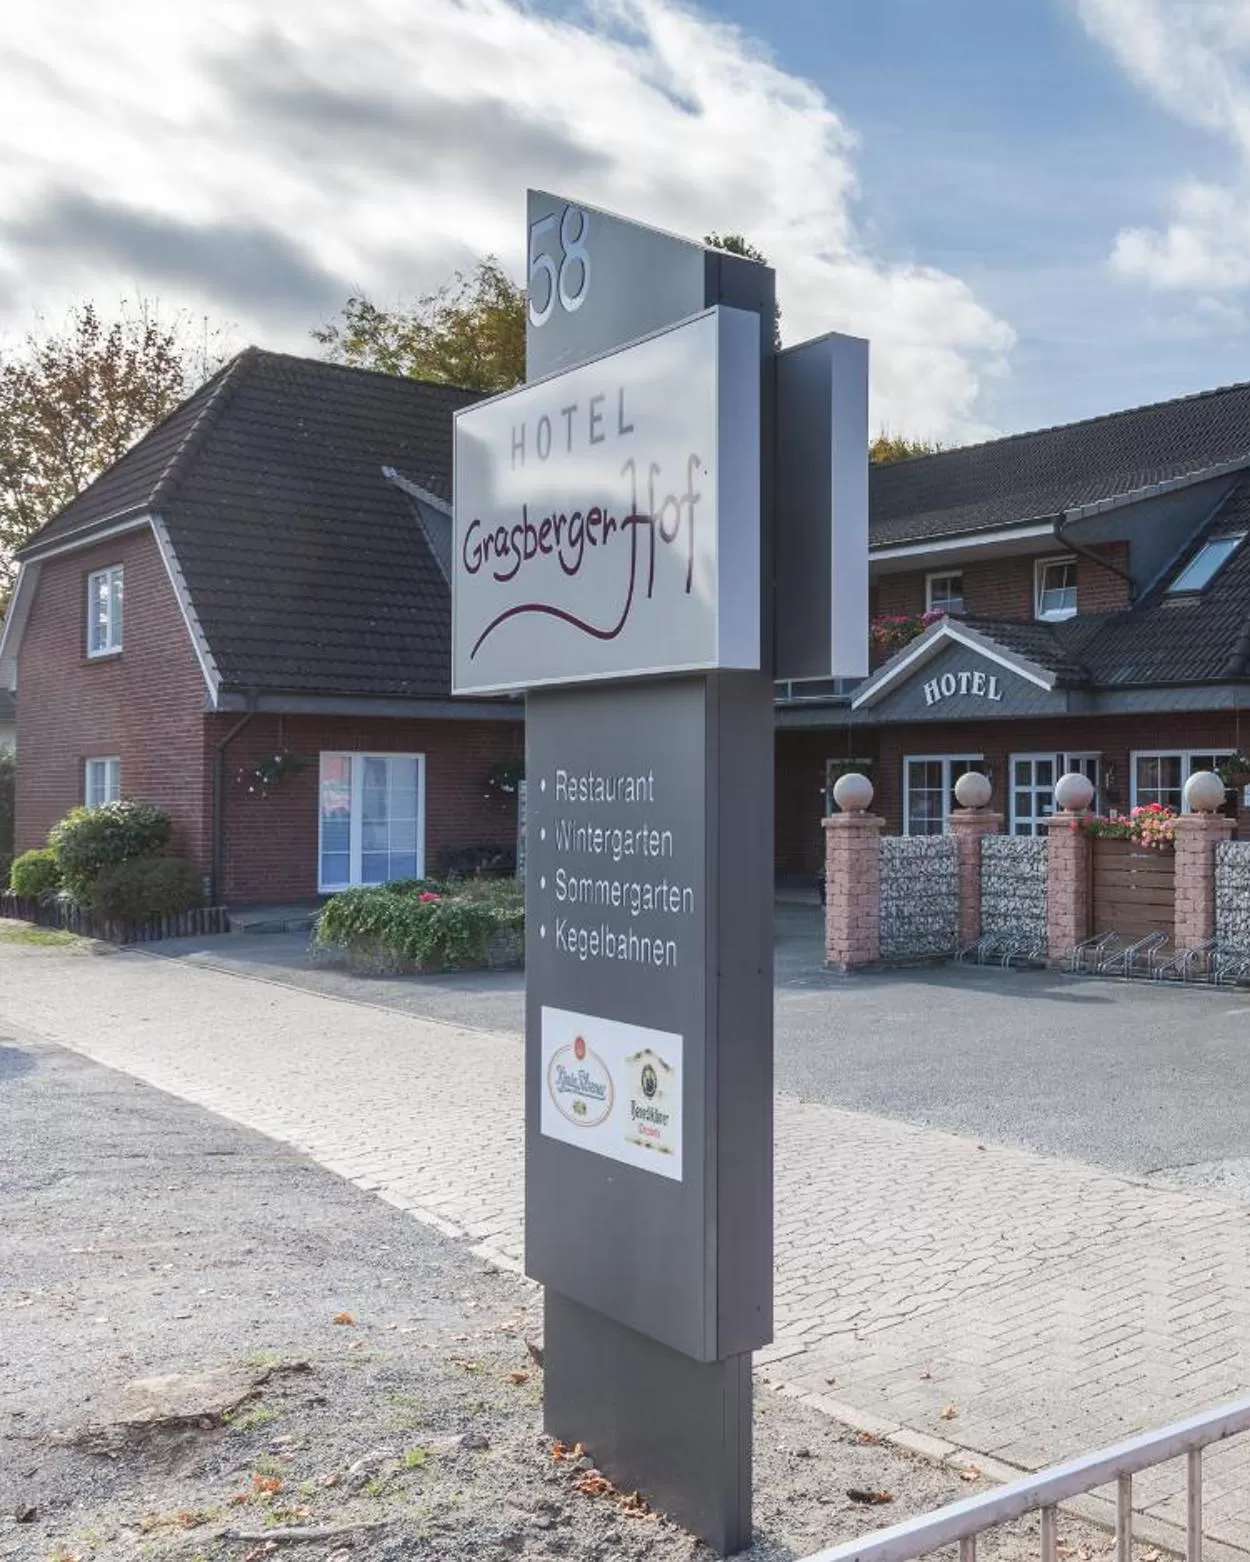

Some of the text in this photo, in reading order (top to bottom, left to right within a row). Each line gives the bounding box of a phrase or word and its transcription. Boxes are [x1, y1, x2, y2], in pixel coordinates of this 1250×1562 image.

[529, 203, 590, 327] 58
[511, 386, 633, 471] HOTEL
[463, 453, 701, 598] Grasberger Hof
[923, 671, 1003, 706] HOTEL
[556, 768, 654, 803] Restaurant
[555, 819, 673, 861] Wintergarten
[555, 868, 694, 915] Sommergarten
[555, 918, 677, 966] Kegelbahnen
